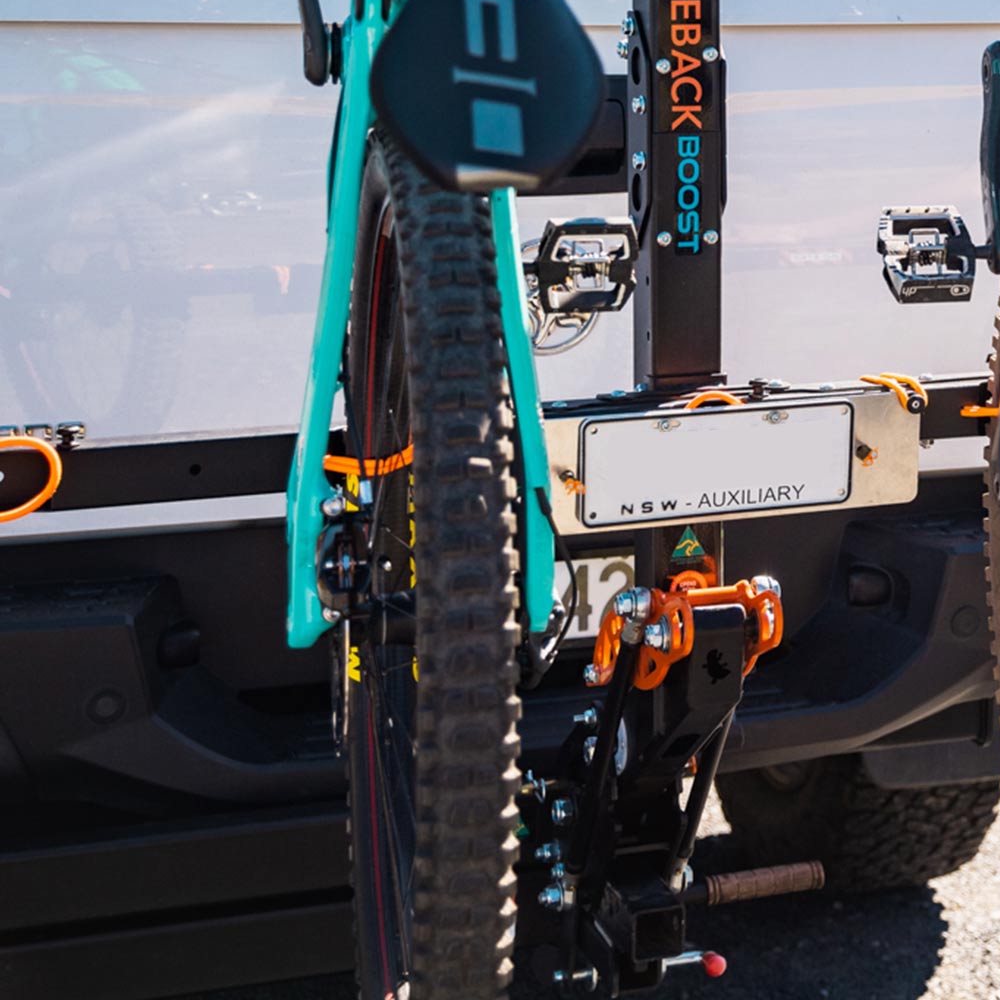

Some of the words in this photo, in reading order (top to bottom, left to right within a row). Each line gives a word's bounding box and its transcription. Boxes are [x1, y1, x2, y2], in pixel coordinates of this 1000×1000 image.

[677, 135, 700, 254] BOOST
[620, 500, 678, 515] NSW
[698, 484, 806, 509] AUXILIARY
